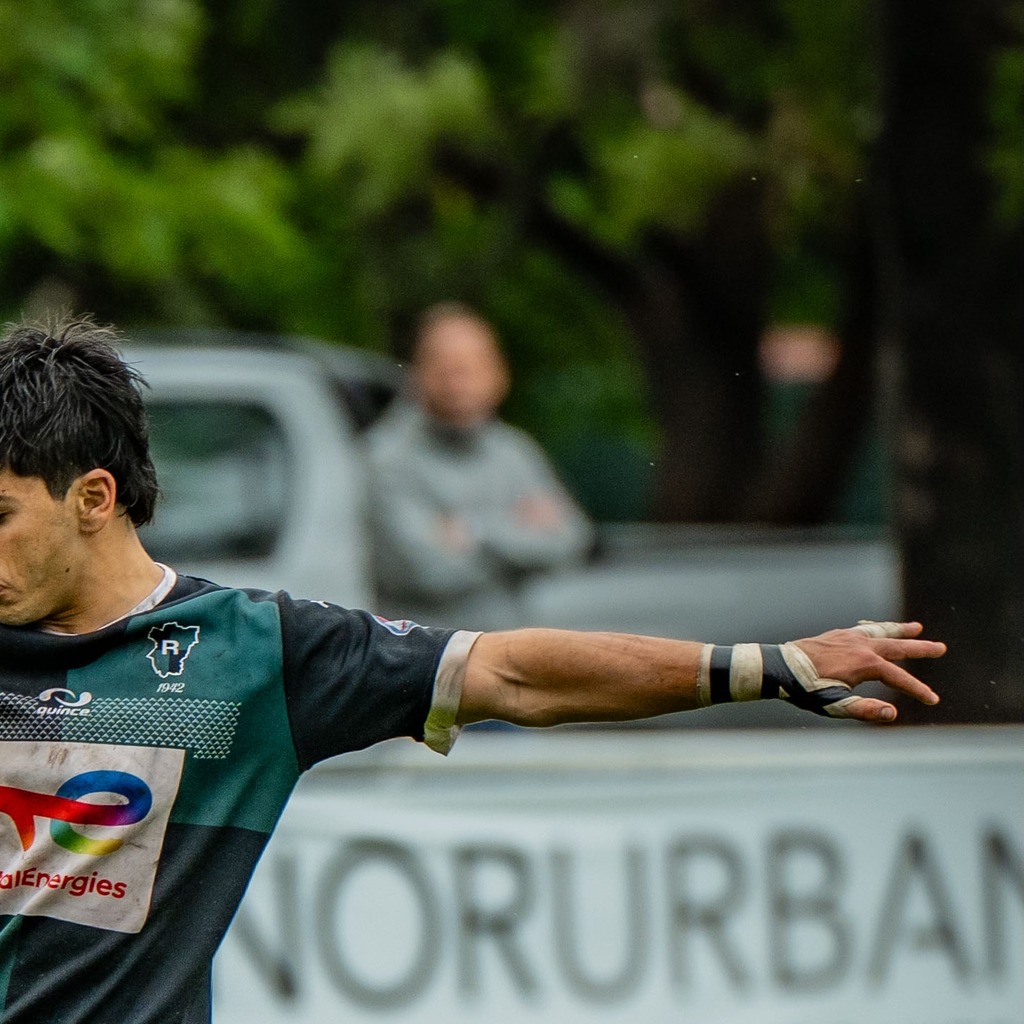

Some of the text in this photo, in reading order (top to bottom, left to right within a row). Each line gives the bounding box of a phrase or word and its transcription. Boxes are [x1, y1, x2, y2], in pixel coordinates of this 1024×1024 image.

[161, 639, 180, 656] R
[156, 682, 186, 693] 1942
[36, 704, 91, 717] quince
